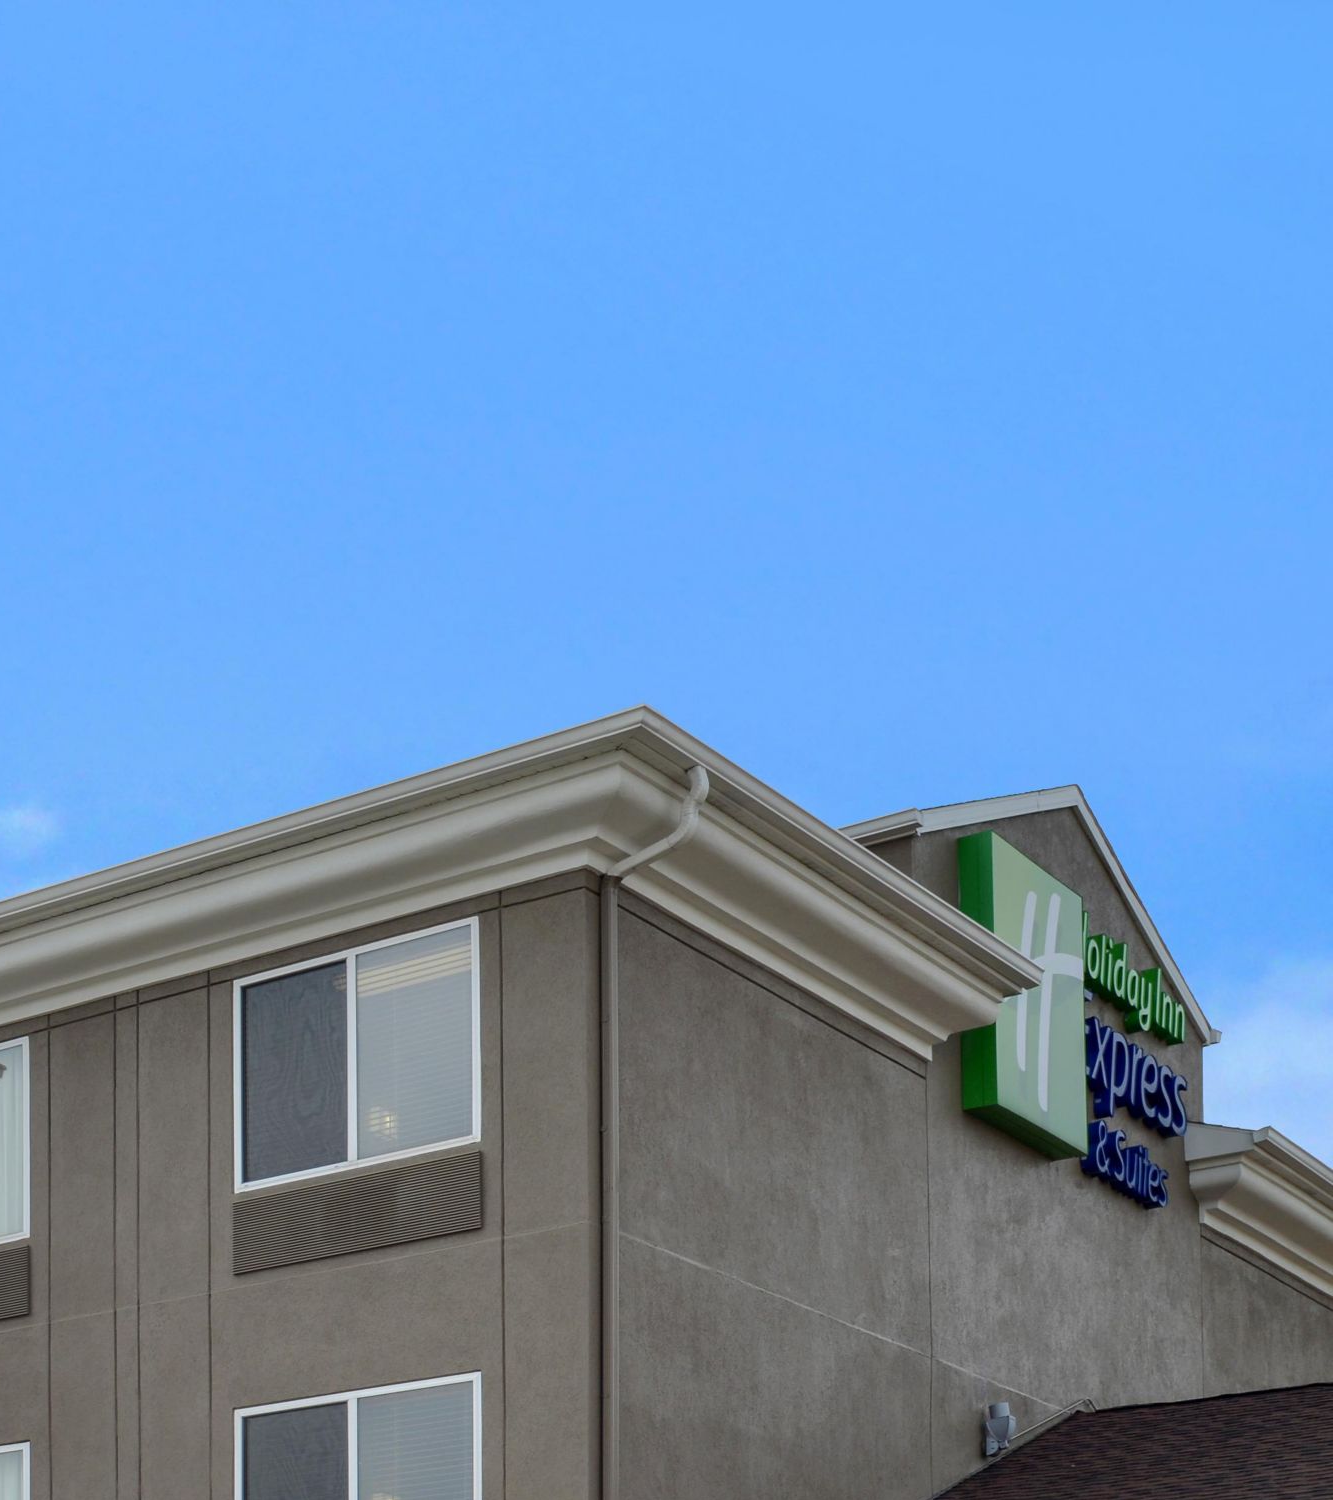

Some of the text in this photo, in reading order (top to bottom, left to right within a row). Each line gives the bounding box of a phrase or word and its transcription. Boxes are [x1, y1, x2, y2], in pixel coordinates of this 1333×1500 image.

[1083, 911, 1186, 1045] oliday Inn
[1085, 1016, 1187, 1137] xpress
[1093, 1120, 1169, 1208] & Suites
